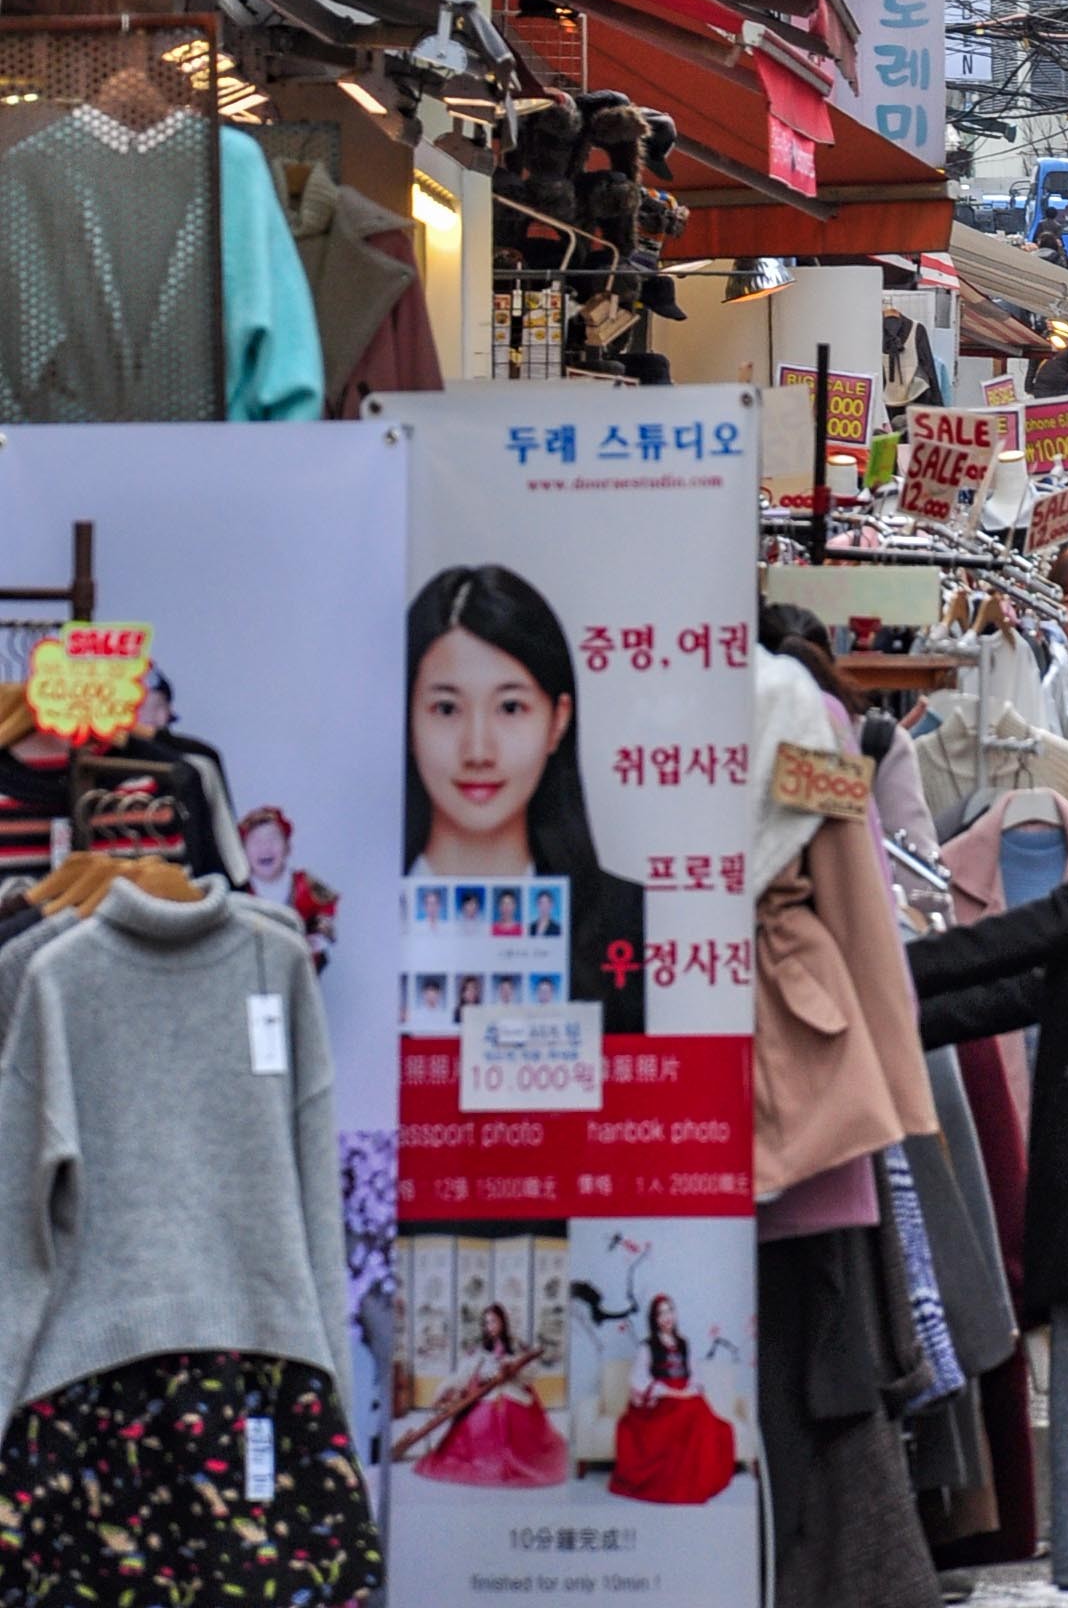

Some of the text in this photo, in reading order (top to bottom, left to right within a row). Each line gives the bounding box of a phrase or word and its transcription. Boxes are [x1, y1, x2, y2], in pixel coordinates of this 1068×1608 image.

[507, 421, 743, 465] 두래 스튜디오
[914, 412, 991, 448] SALE
[613, 745, 750, 787] 취업사진
[646, 853, 748, 893] 프로필
[601, 938, 753, 989] 우정사진
[481, 1122, 544, 1148] photo
[671, 1120, 731, 1145] photo
